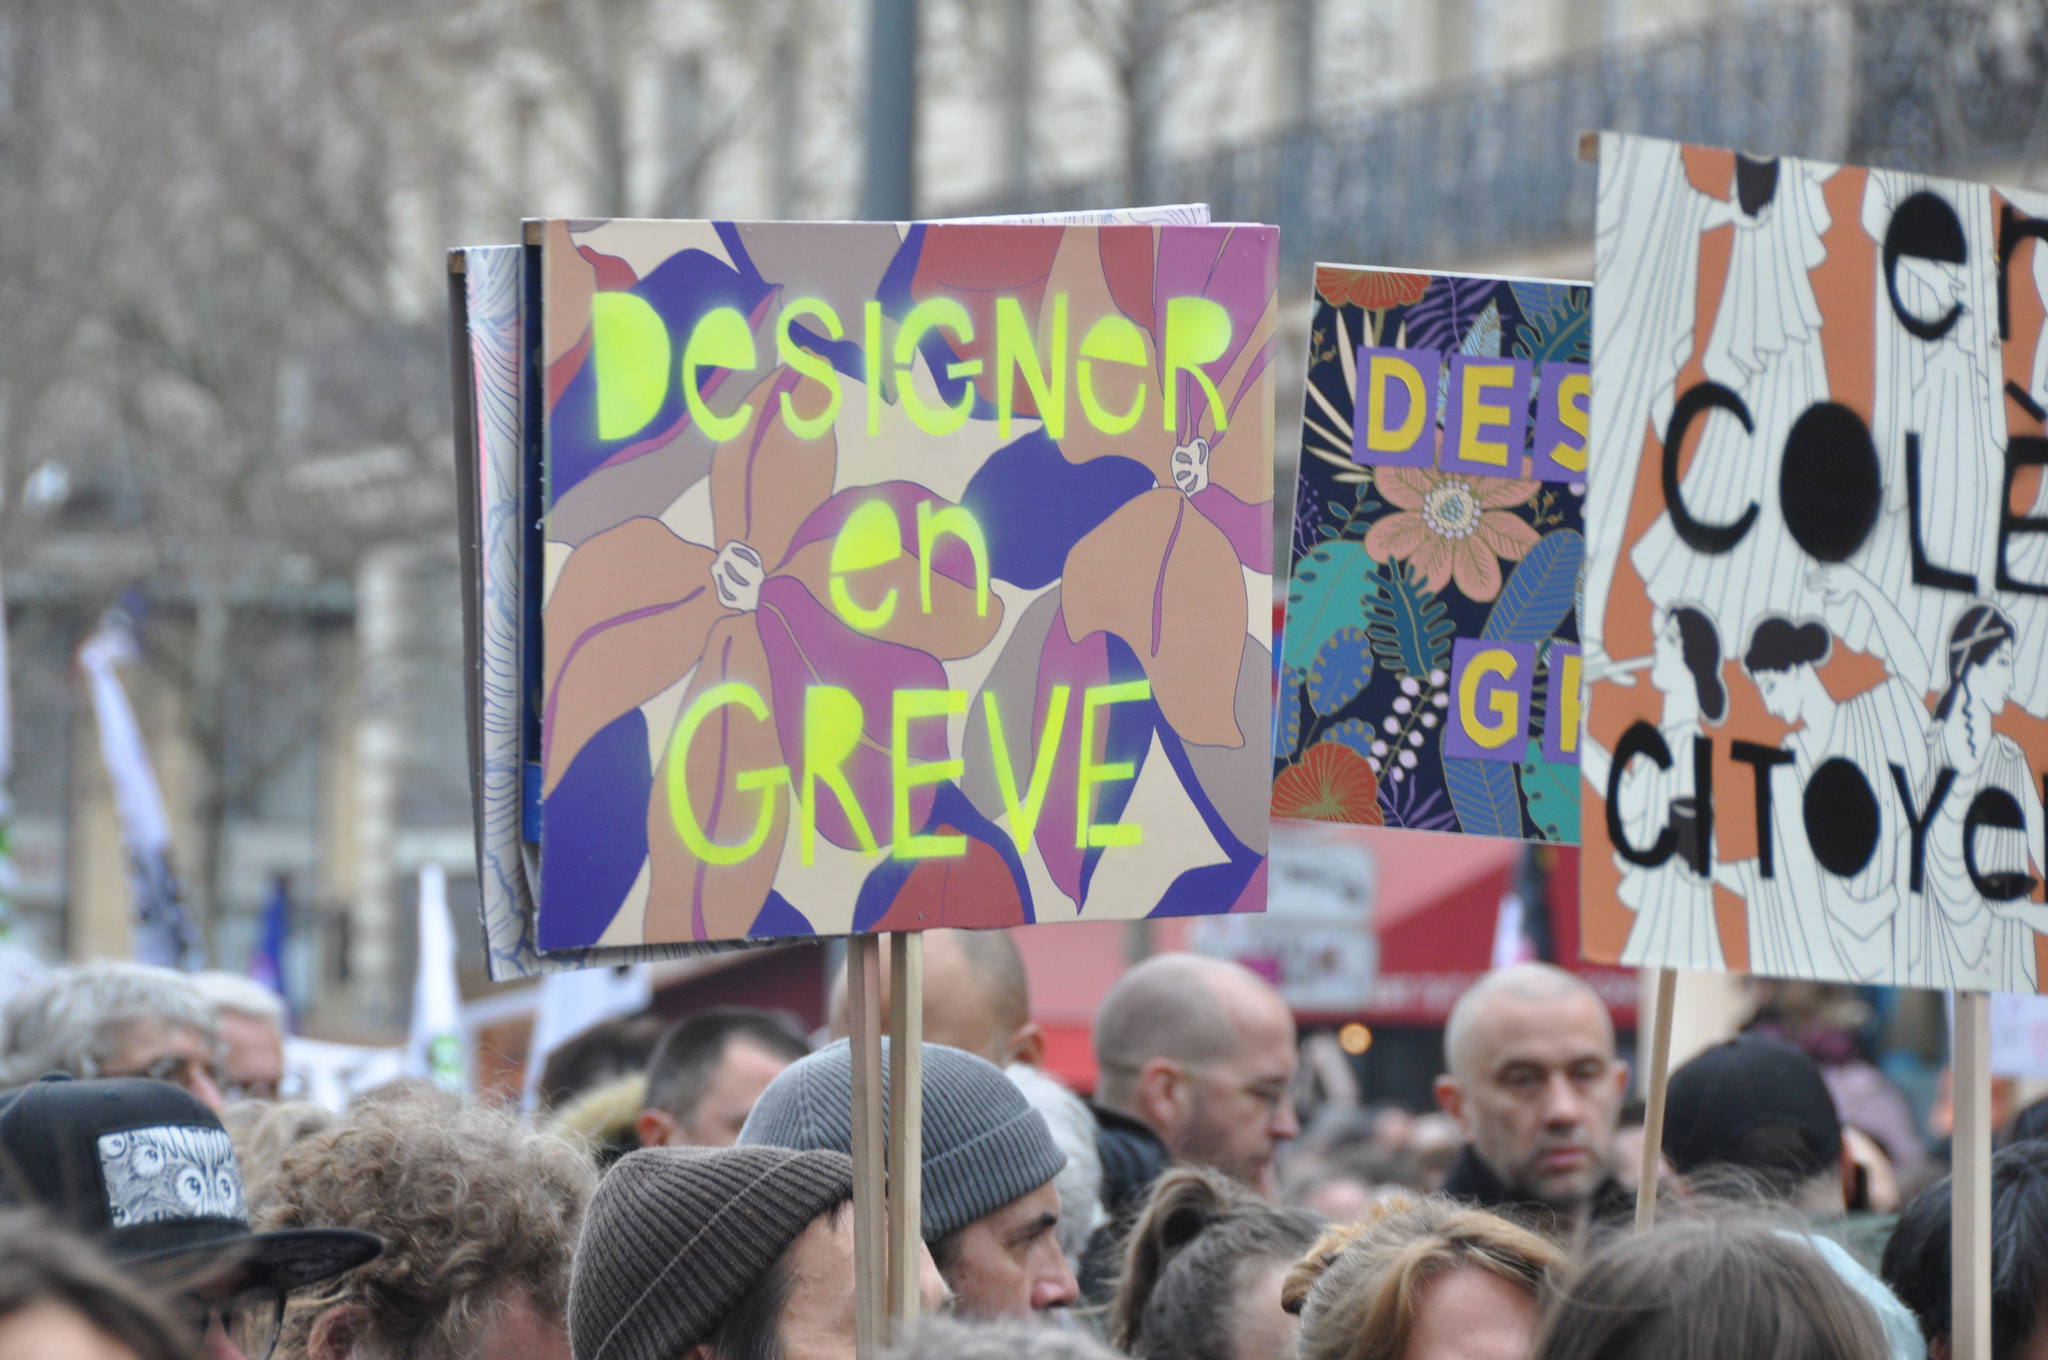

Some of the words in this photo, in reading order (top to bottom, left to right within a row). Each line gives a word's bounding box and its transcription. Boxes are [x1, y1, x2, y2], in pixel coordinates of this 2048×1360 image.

[1366, 355, 1590, 473] DES
[829, 499, 989, 629] en
[668, 680, 1151, 866] GREVE
[1604, 720, 2048, 902] CITOYe
